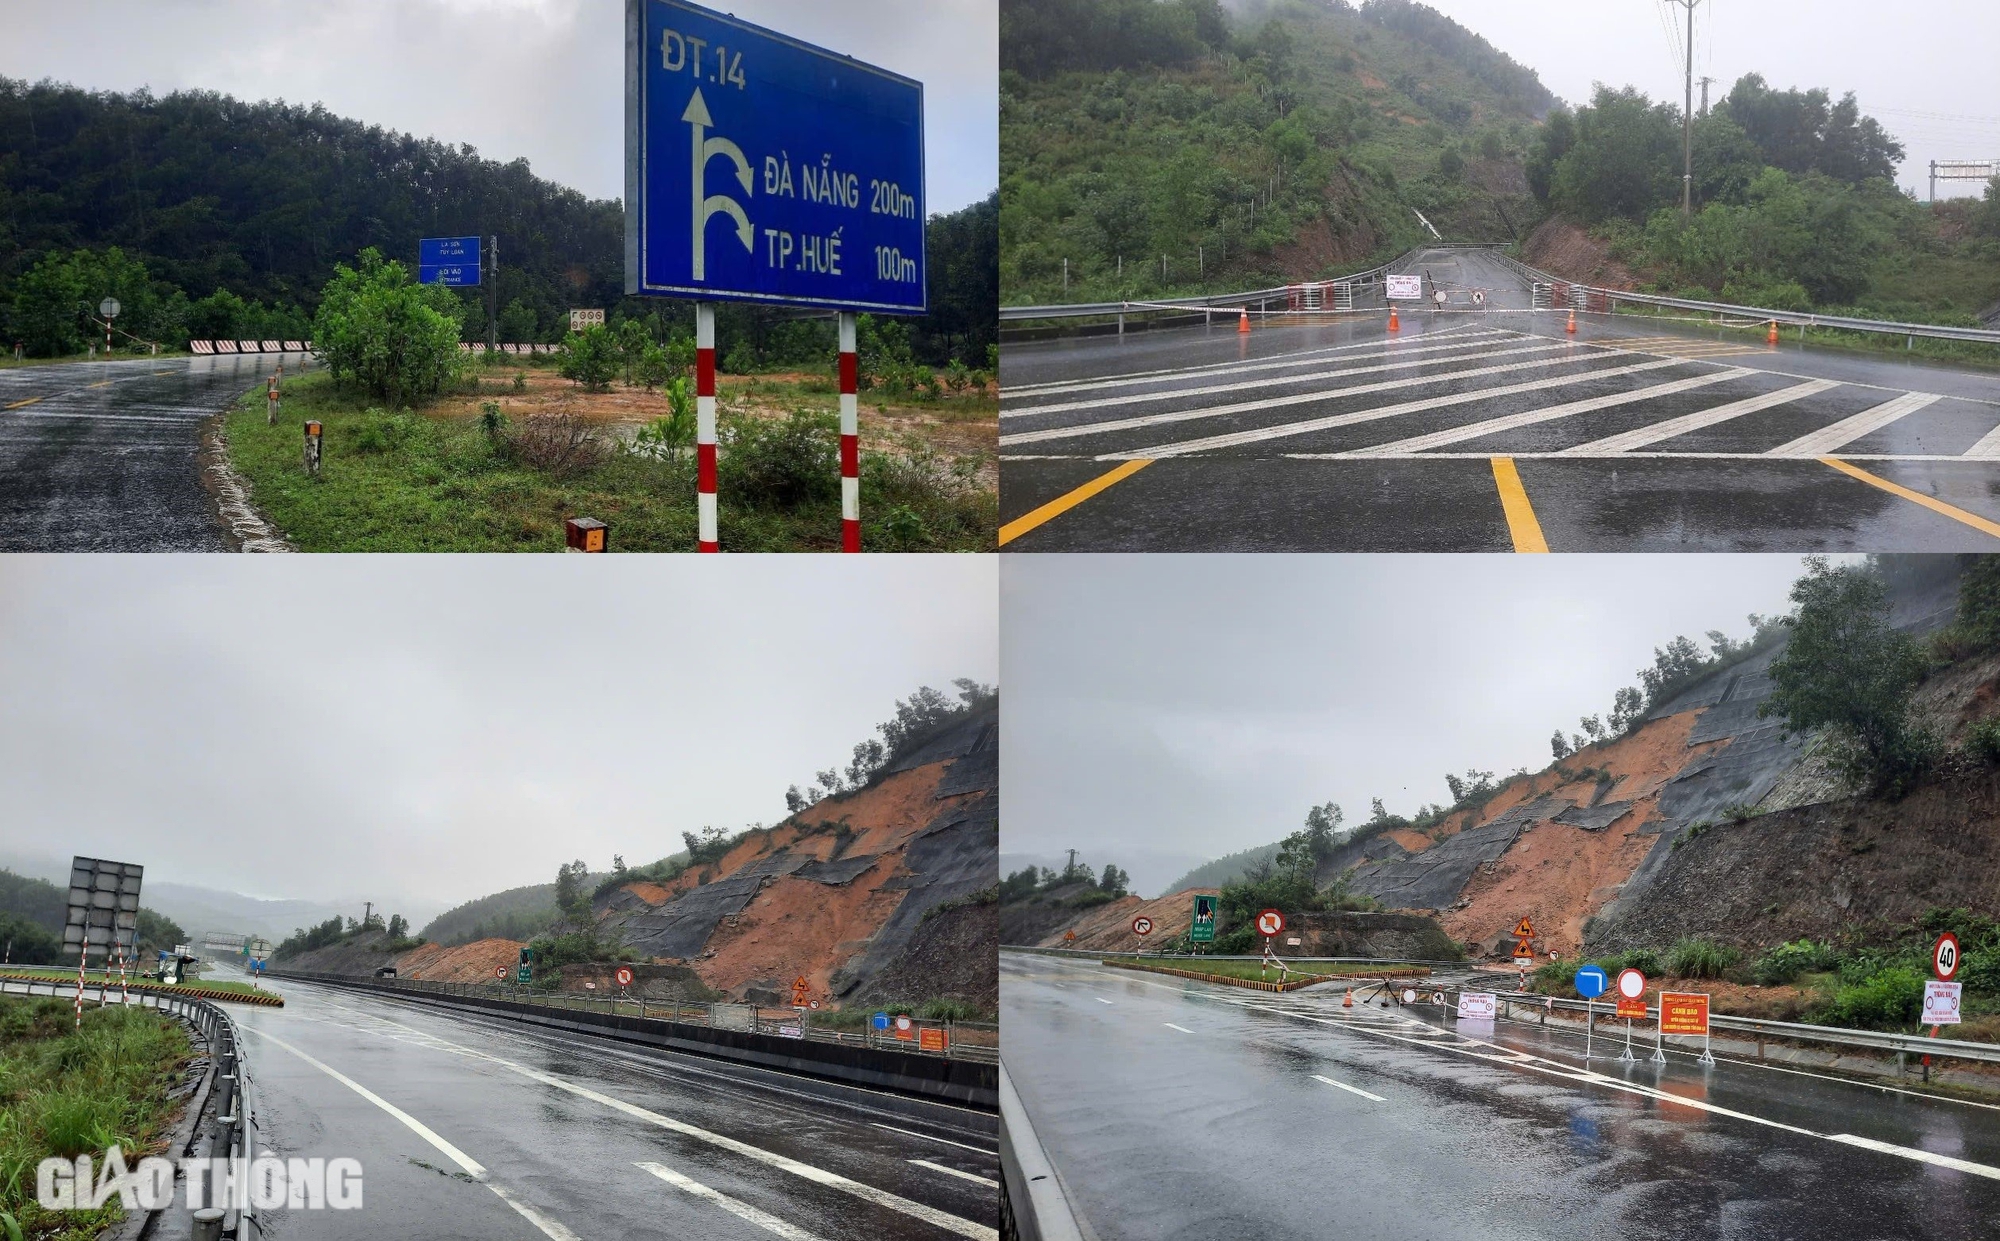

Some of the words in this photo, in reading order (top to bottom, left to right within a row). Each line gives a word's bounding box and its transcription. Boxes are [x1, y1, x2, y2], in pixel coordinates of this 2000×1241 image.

[661, 28, 746, 91] ĐT.14
[764, 150, 795, 199] ĐÀ
[803, 153, 859, 209] NẴNG
[871, 178, 915, 220] 200m
[765, 226, 843, 276] TP.HUẾ
[875, 245, 917, 284] 100m
[1939, 947, 1954, 968] 40
